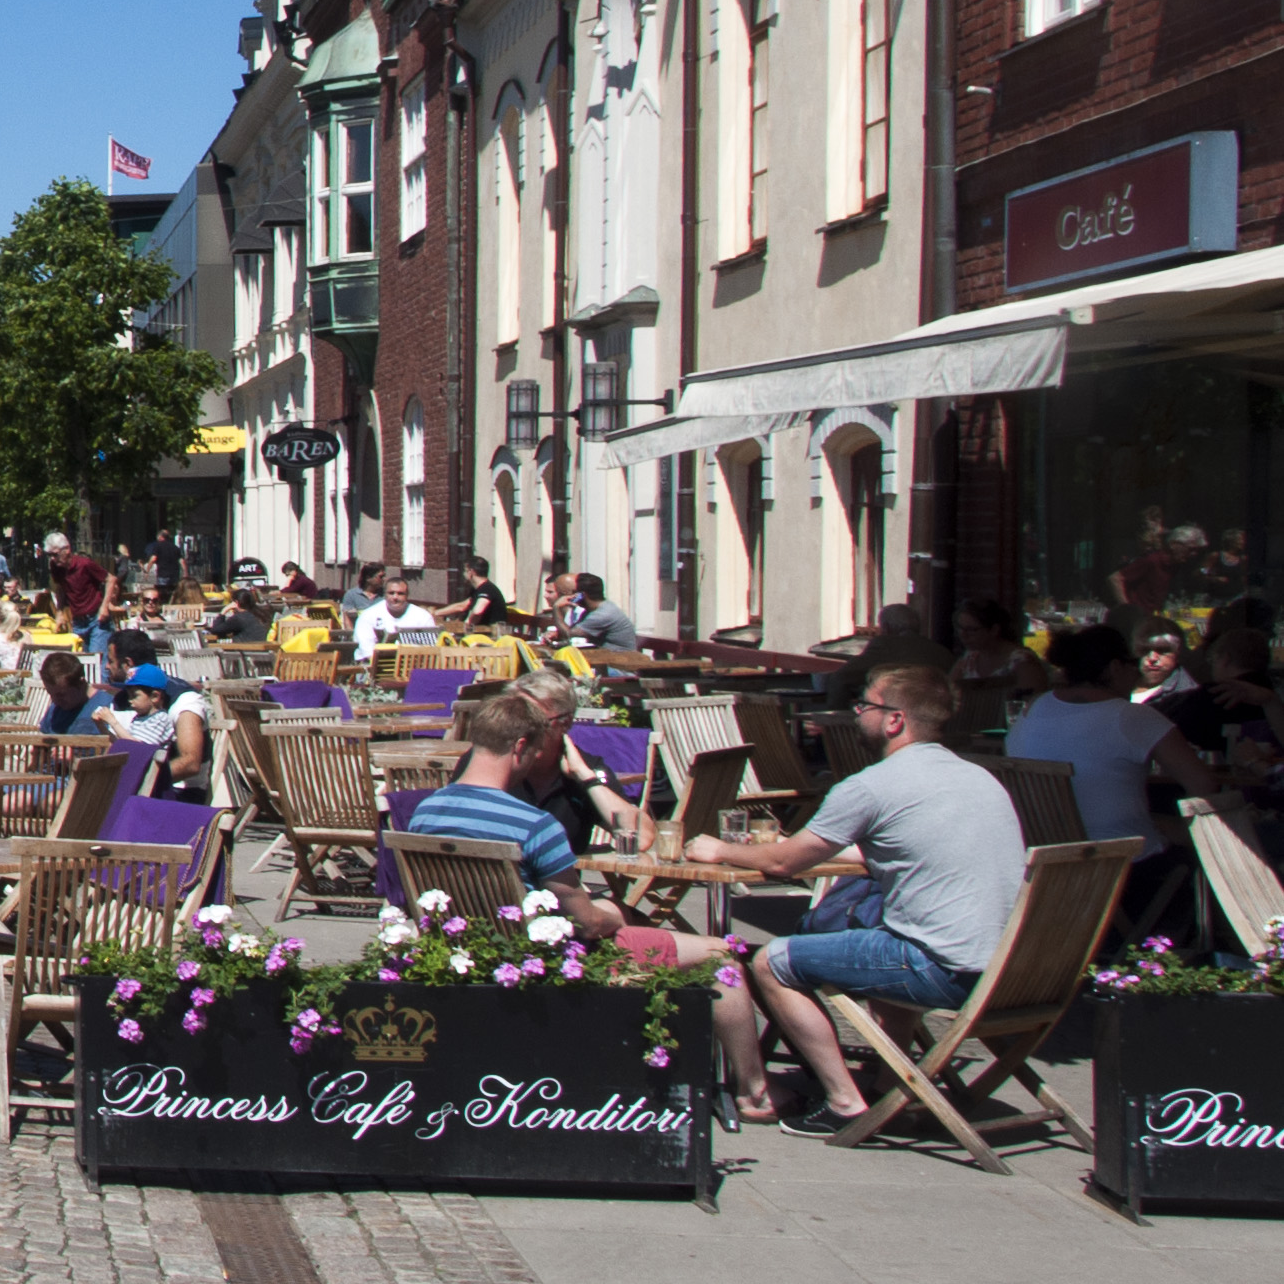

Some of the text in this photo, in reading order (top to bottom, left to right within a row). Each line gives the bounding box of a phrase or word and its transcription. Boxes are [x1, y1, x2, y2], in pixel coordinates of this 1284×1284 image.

[1055, 184, 1135, 250] Café
[98, 1063, 298, 1121] Princess
[307, 1070, 416, 1140] Café
[465, 1074, 693, 1133] Konditori
